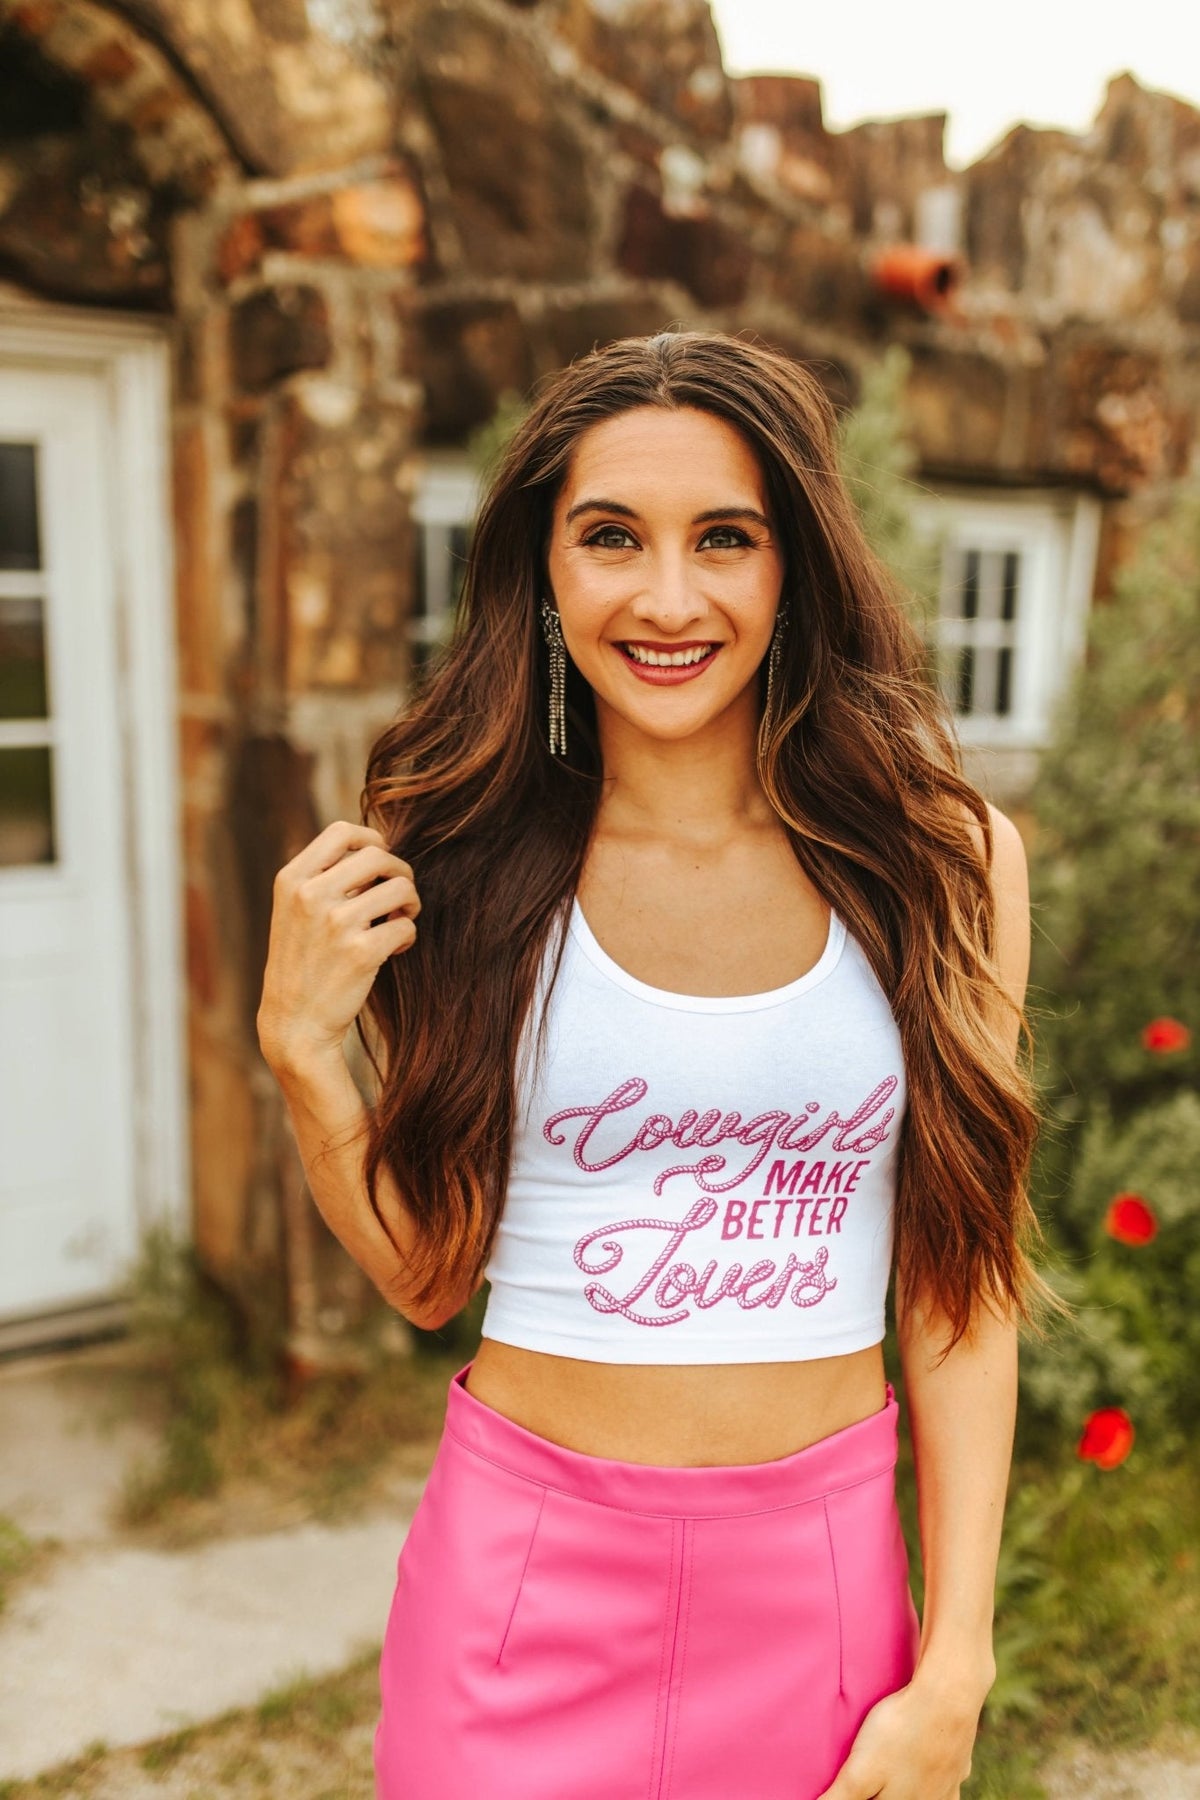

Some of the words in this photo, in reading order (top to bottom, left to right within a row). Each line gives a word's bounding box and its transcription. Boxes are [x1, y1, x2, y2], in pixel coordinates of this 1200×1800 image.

[543, 1075, 898, 1196] Cowgirls
[721, 1197, 848, 1240] BETTER
[763, 1160, 870, 1196] MAKE
[573, 1197, 837, 1327] Lovers
